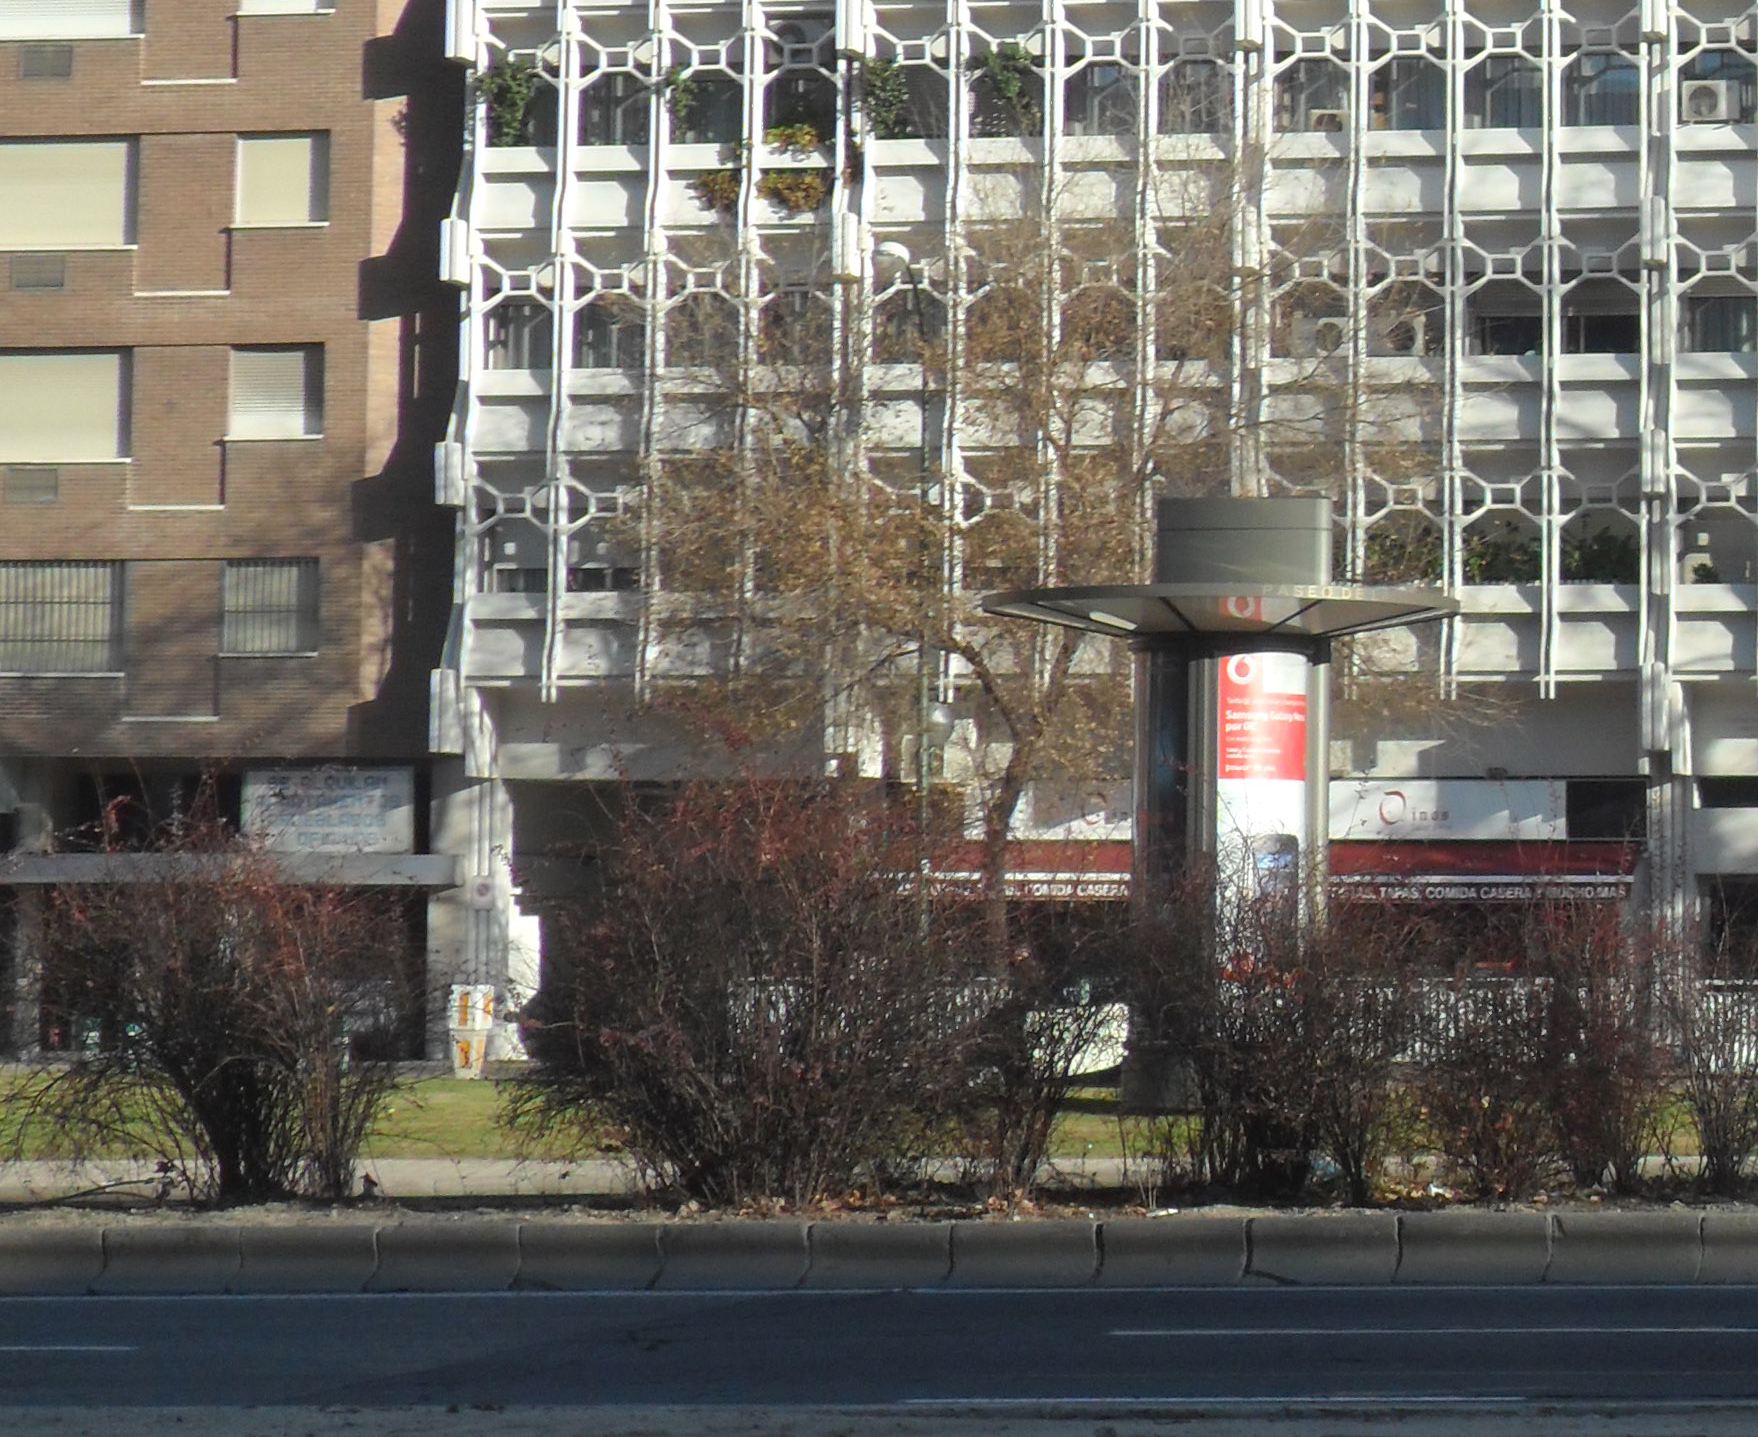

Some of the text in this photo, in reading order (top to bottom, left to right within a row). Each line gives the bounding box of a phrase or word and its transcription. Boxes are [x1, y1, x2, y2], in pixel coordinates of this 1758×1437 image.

[1262, 584, 1333, 598] PASEO
[1341, 586, 1364, 600] DE
[1225, 710, 1269, 722] Samsung
[1425, 886, 1477, 899] COMIDA
